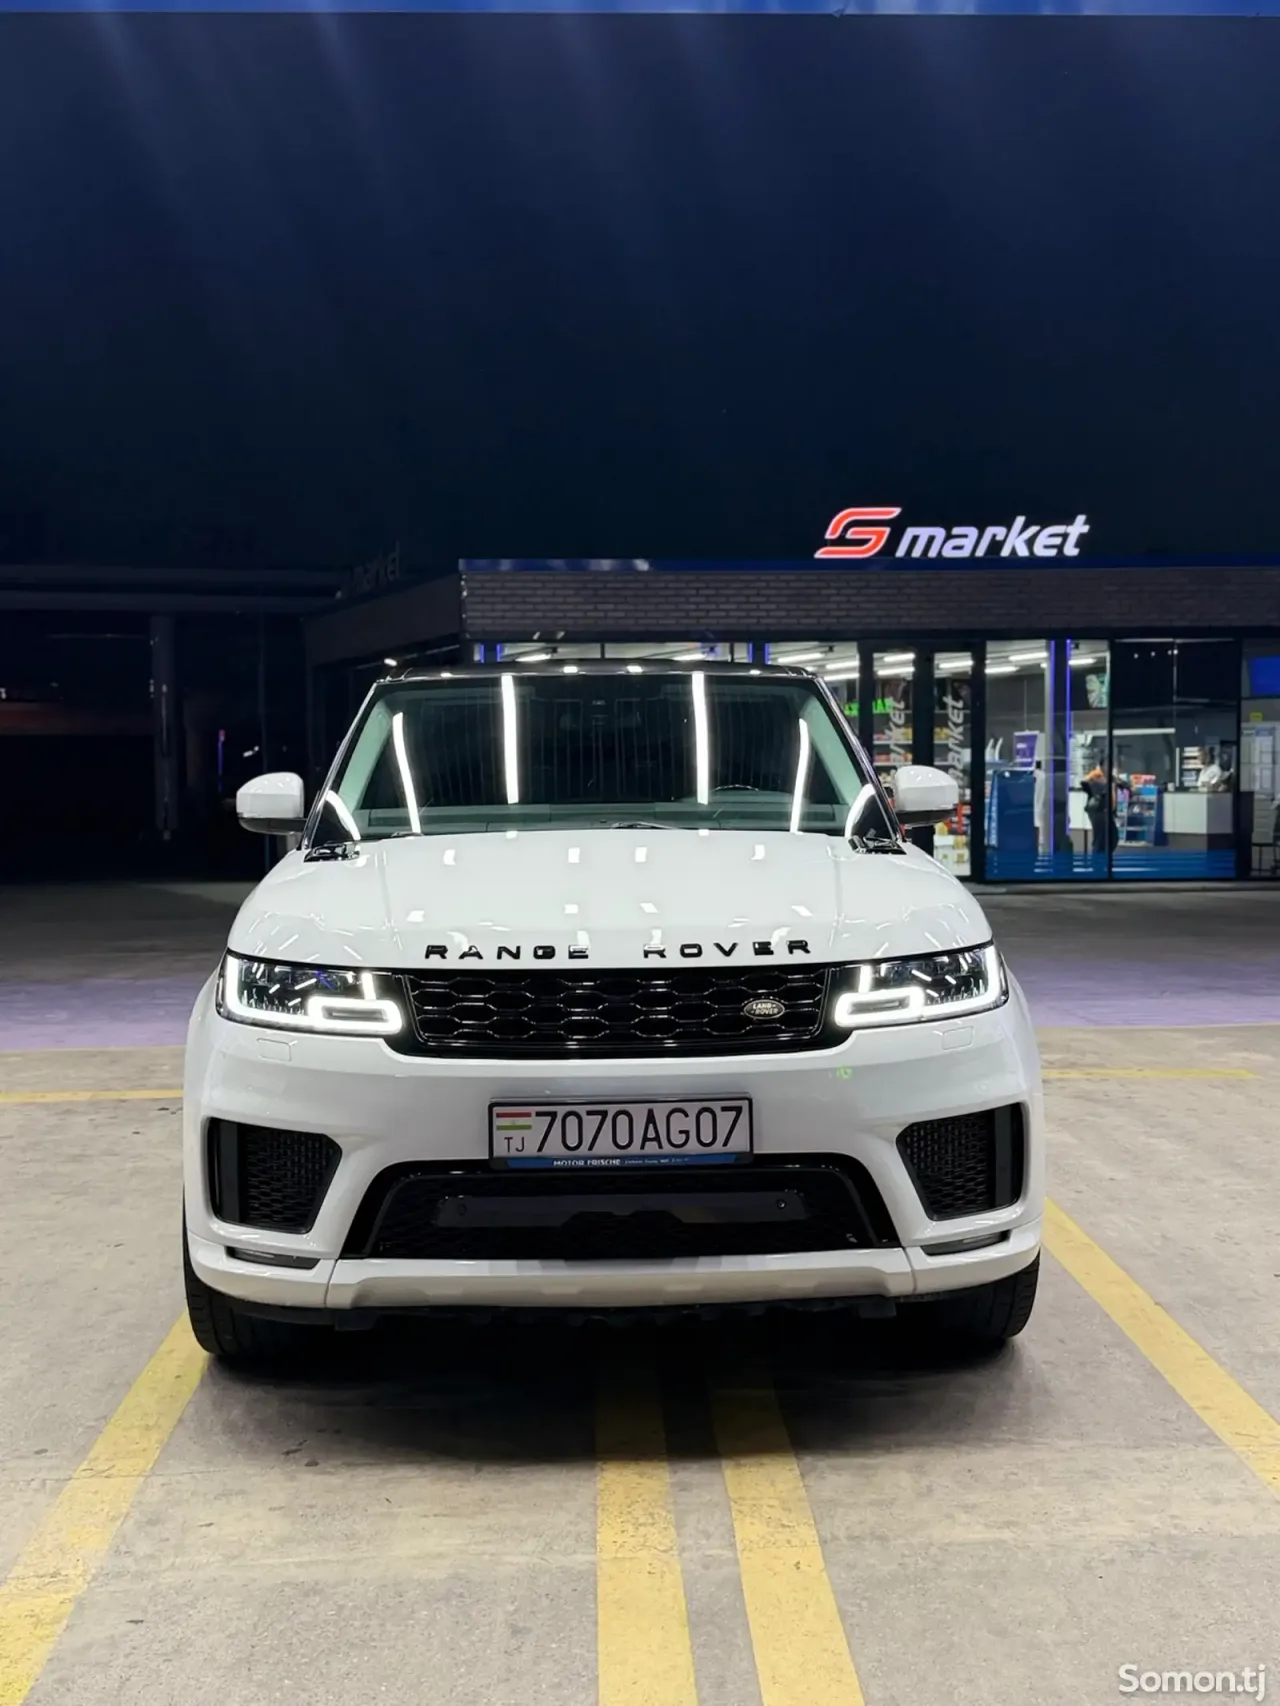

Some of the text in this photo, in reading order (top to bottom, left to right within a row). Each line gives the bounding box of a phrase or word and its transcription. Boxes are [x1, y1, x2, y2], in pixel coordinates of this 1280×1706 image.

[895, 514, 1090, 558] market
[424, 939, 811, 960] RANGE ROVER
[503, 1105, 743, 1153] TJ 7070AG07
[553, 1159, 585, 1167] MOTOR
